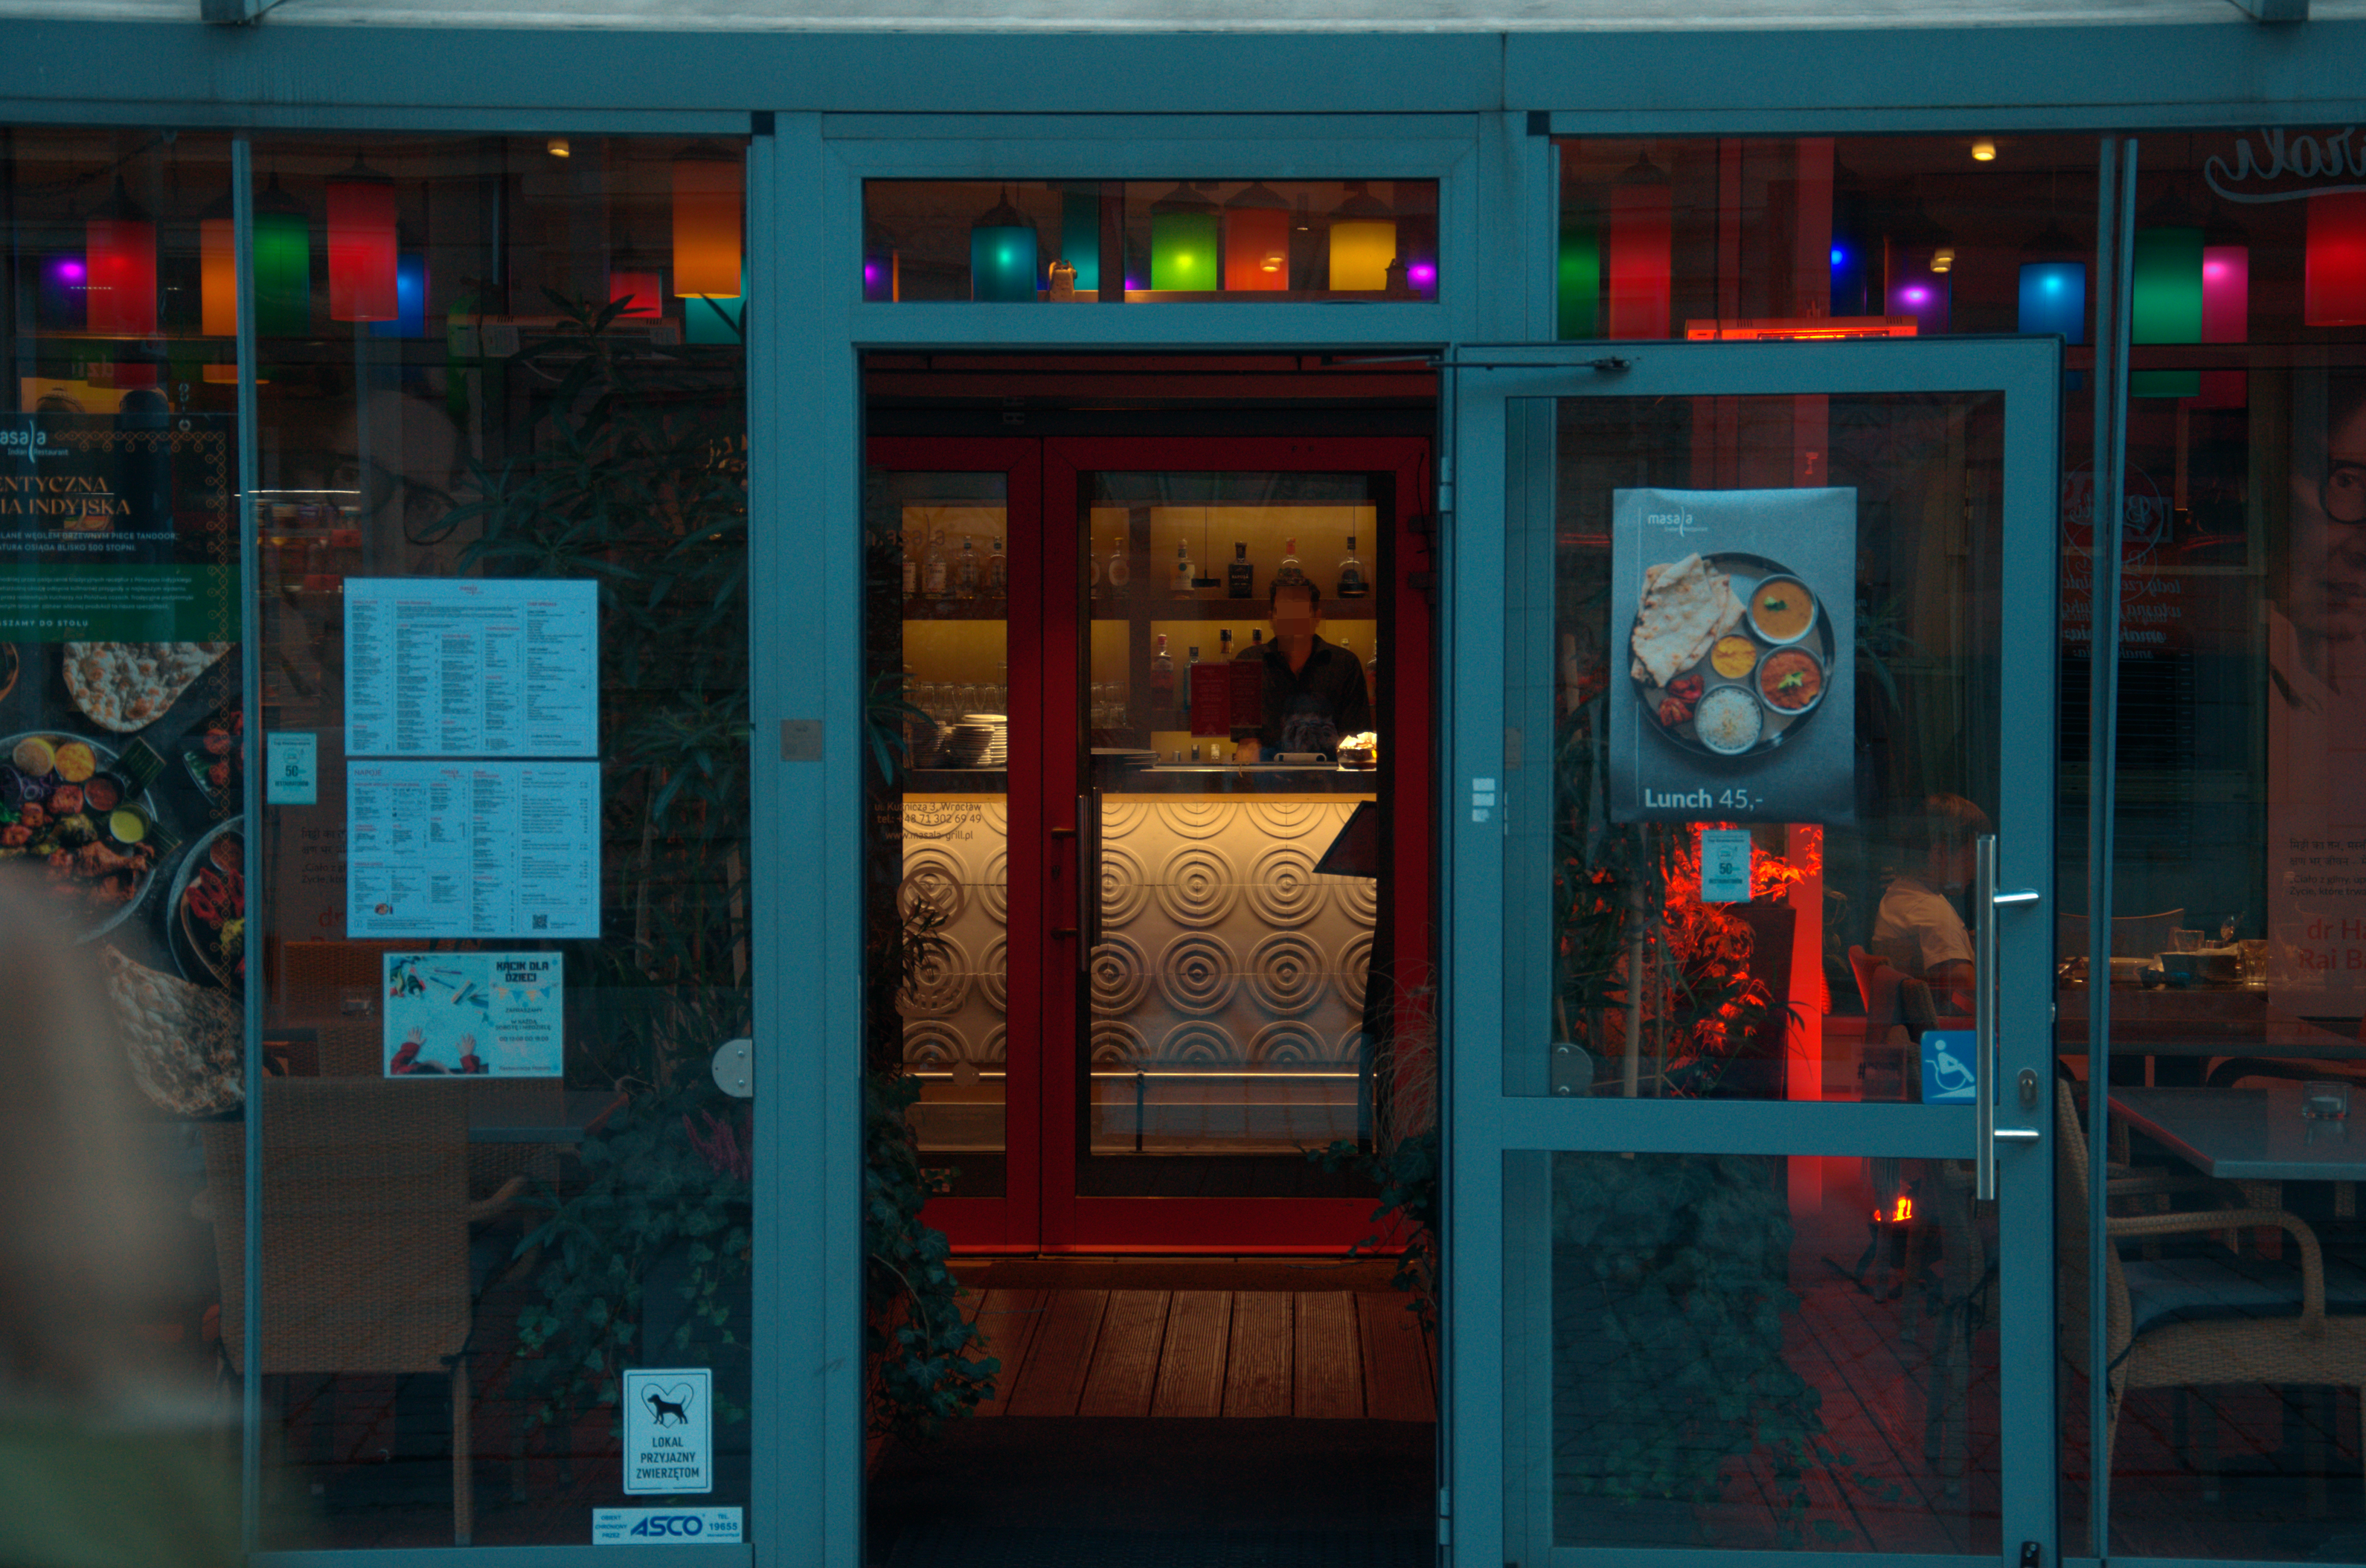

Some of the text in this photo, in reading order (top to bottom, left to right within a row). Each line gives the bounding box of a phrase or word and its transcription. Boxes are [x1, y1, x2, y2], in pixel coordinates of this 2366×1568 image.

[30, 498, 132, 517] INDYJSKA
[1647, 506, 1693, 537] masala
[25, 532, 60, 540] WĘGLEM
[25, 543, 55, 553] OSIĄGA
[57, 543, 86, 551] BLISKO
[88, 543, 103, 551] 500
[106, 543, 136, 551] STOPNI.
[1645, 788, 1763, 812] Lunch 45,-
[874, 802, 981, 812] ul. Kuźnicza 3, Wrocław
[877, 814, 981, 823] tel.: +48 71 302 69 49
[2312, 841, 2324, 850] का
[2290, 886, 2316, 897] Życie,
[2319, 886, 2344, 896] które
[318, 905, 344, 927] dr
[2307, 918, 2366, 940] dr H
[2299, 948, 2366, 970] Rai B
[496, 961, 549, 973] KĄCIK DLA
[505, 972, 536, 982] DZIECI
[653, 1437, 684, 1447] LOKAL
[641, 1452, 696, 1464] PRZYJAZNY
[636, 1467, 699, 1480] ZWIERZĘTOM
[630, 1515, 703, 1537] ASCO
[709, 1522, 738, 1531] 19655
